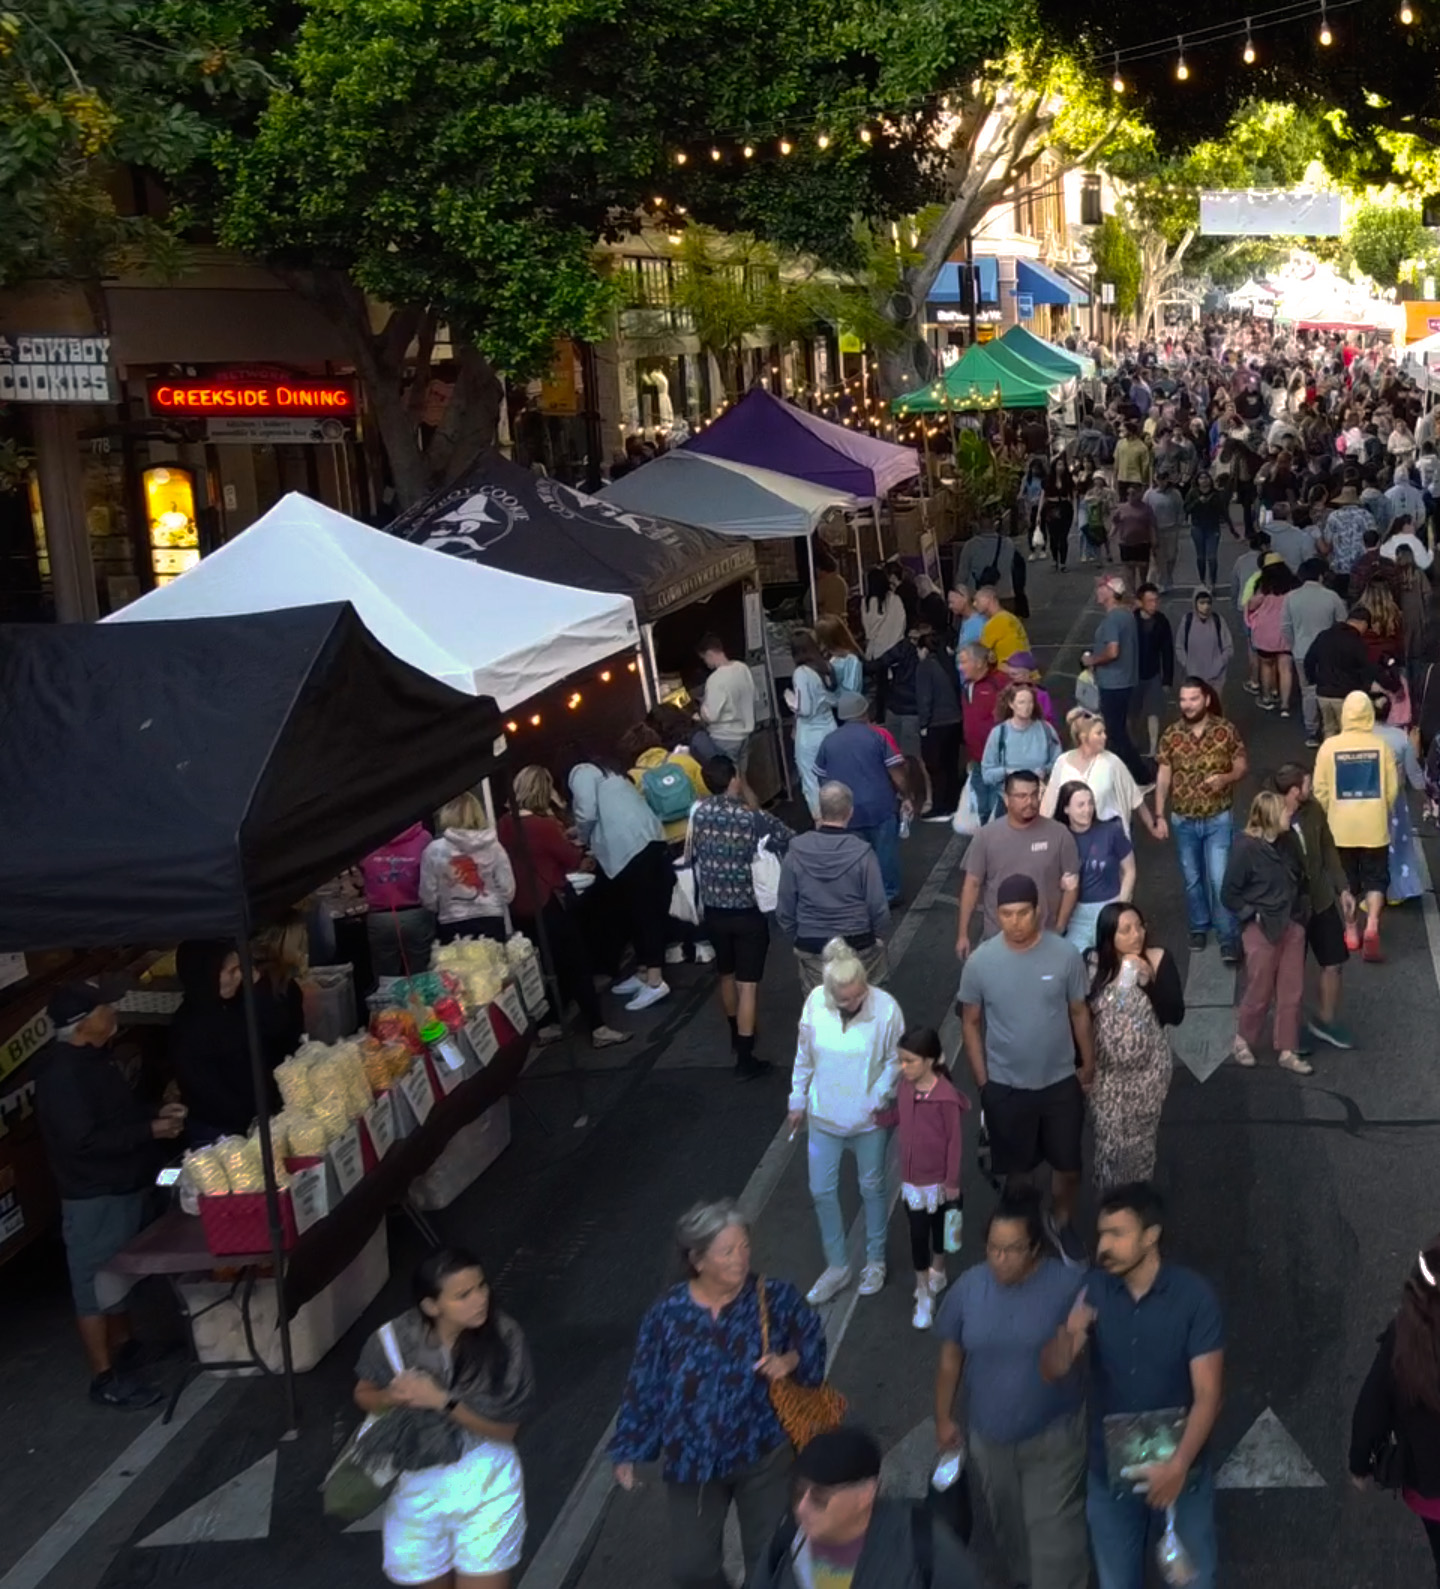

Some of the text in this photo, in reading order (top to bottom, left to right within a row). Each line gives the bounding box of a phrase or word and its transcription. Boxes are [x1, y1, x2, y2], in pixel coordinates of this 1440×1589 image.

[18, 337, 111, 362] COWBOY
[0, 363, 110, 401] COOKIES
[157, 386, 348, 406] CREEKSIDE DINING
